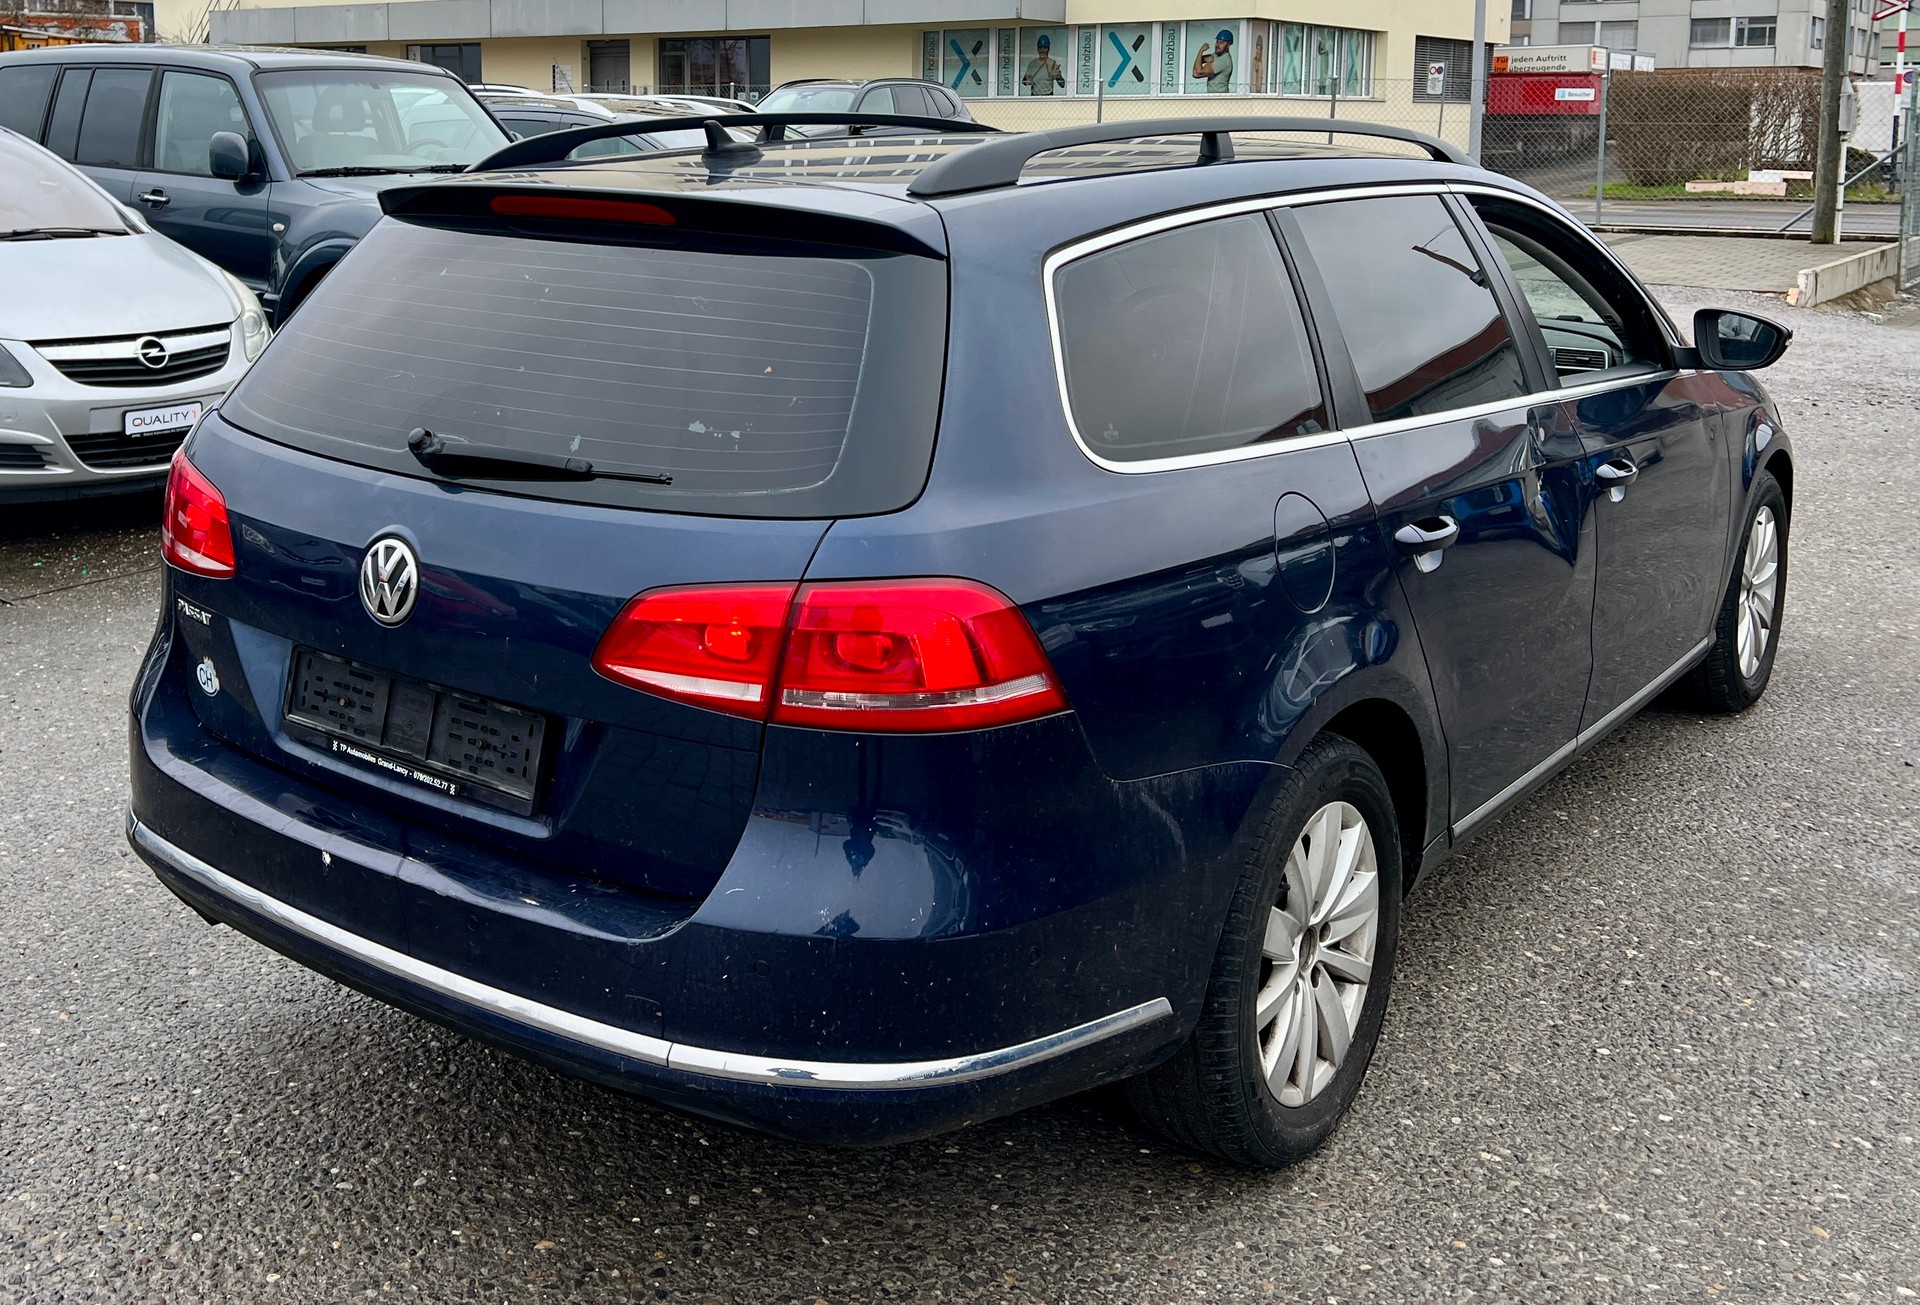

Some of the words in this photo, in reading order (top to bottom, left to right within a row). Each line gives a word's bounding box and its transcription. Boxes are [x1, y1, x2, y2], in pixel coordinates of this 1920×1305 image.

[1508, 64, 1567, 72] überzeugende
[1511, 55, 1534, 64] jeden
[1535, 54, 1567, 62] Auftritt
[132, 411, 189, 427] QUALITY
[177, 598, 212, 626] PASSAT
[199, 667, 214, 690] CH
[340, 743, 347, 752] TP
[347, 745, 376, 763] Automobiles
[377, 758, 409, 777] Grand-Lancy
